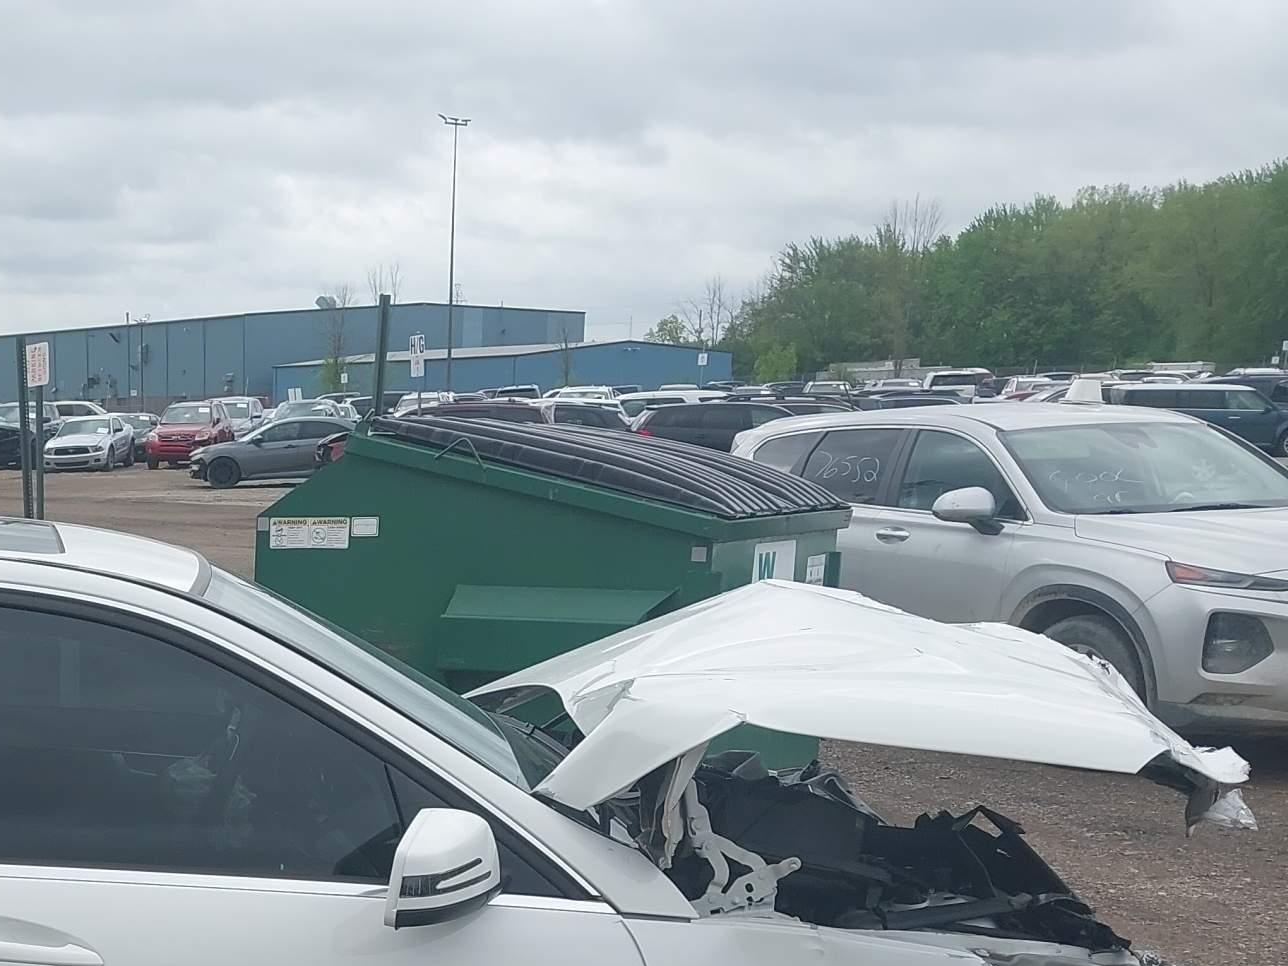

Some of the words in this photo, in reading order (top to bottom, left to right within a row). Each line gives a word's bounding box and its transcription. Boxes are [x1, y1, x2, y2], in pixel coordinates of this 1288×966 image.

[411, 336, 424, 354] H/G
[316, 518, 348, 526] WARNING
[758, 551, 777, 581] W
